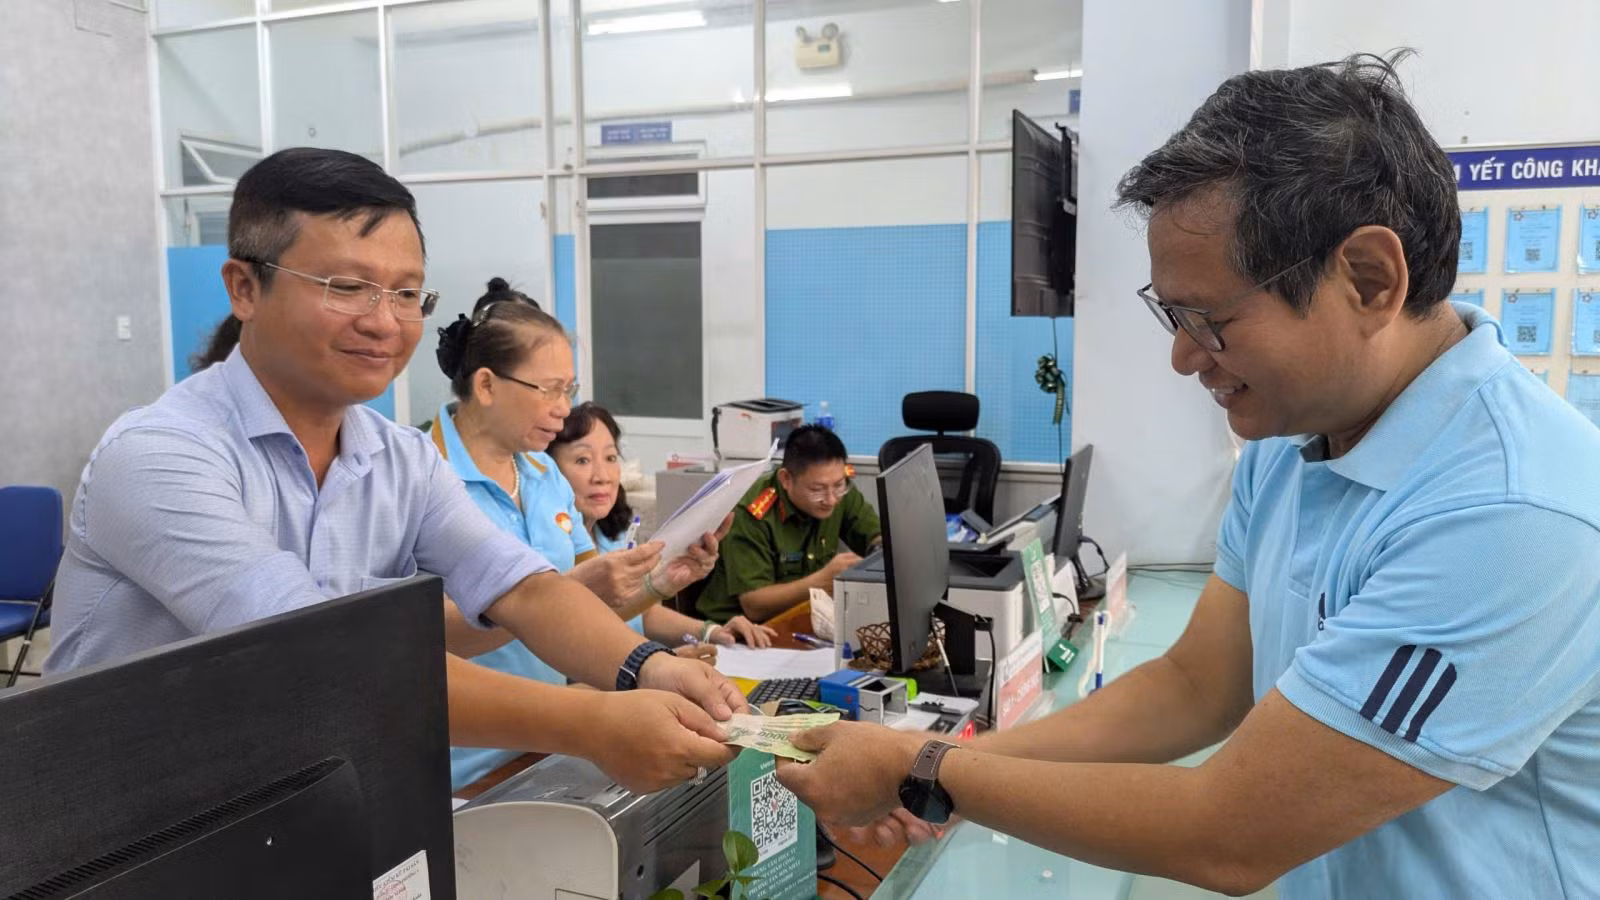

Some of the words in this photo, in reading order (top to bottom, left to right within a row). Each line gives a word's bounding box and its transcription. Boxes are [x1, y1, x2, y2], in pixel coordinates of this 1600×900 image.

[1469, 156, 1505, 181] YẾT
[1511, 157, 1563, 180] CÔNG
[1571, 158, 1600, 177] KH
